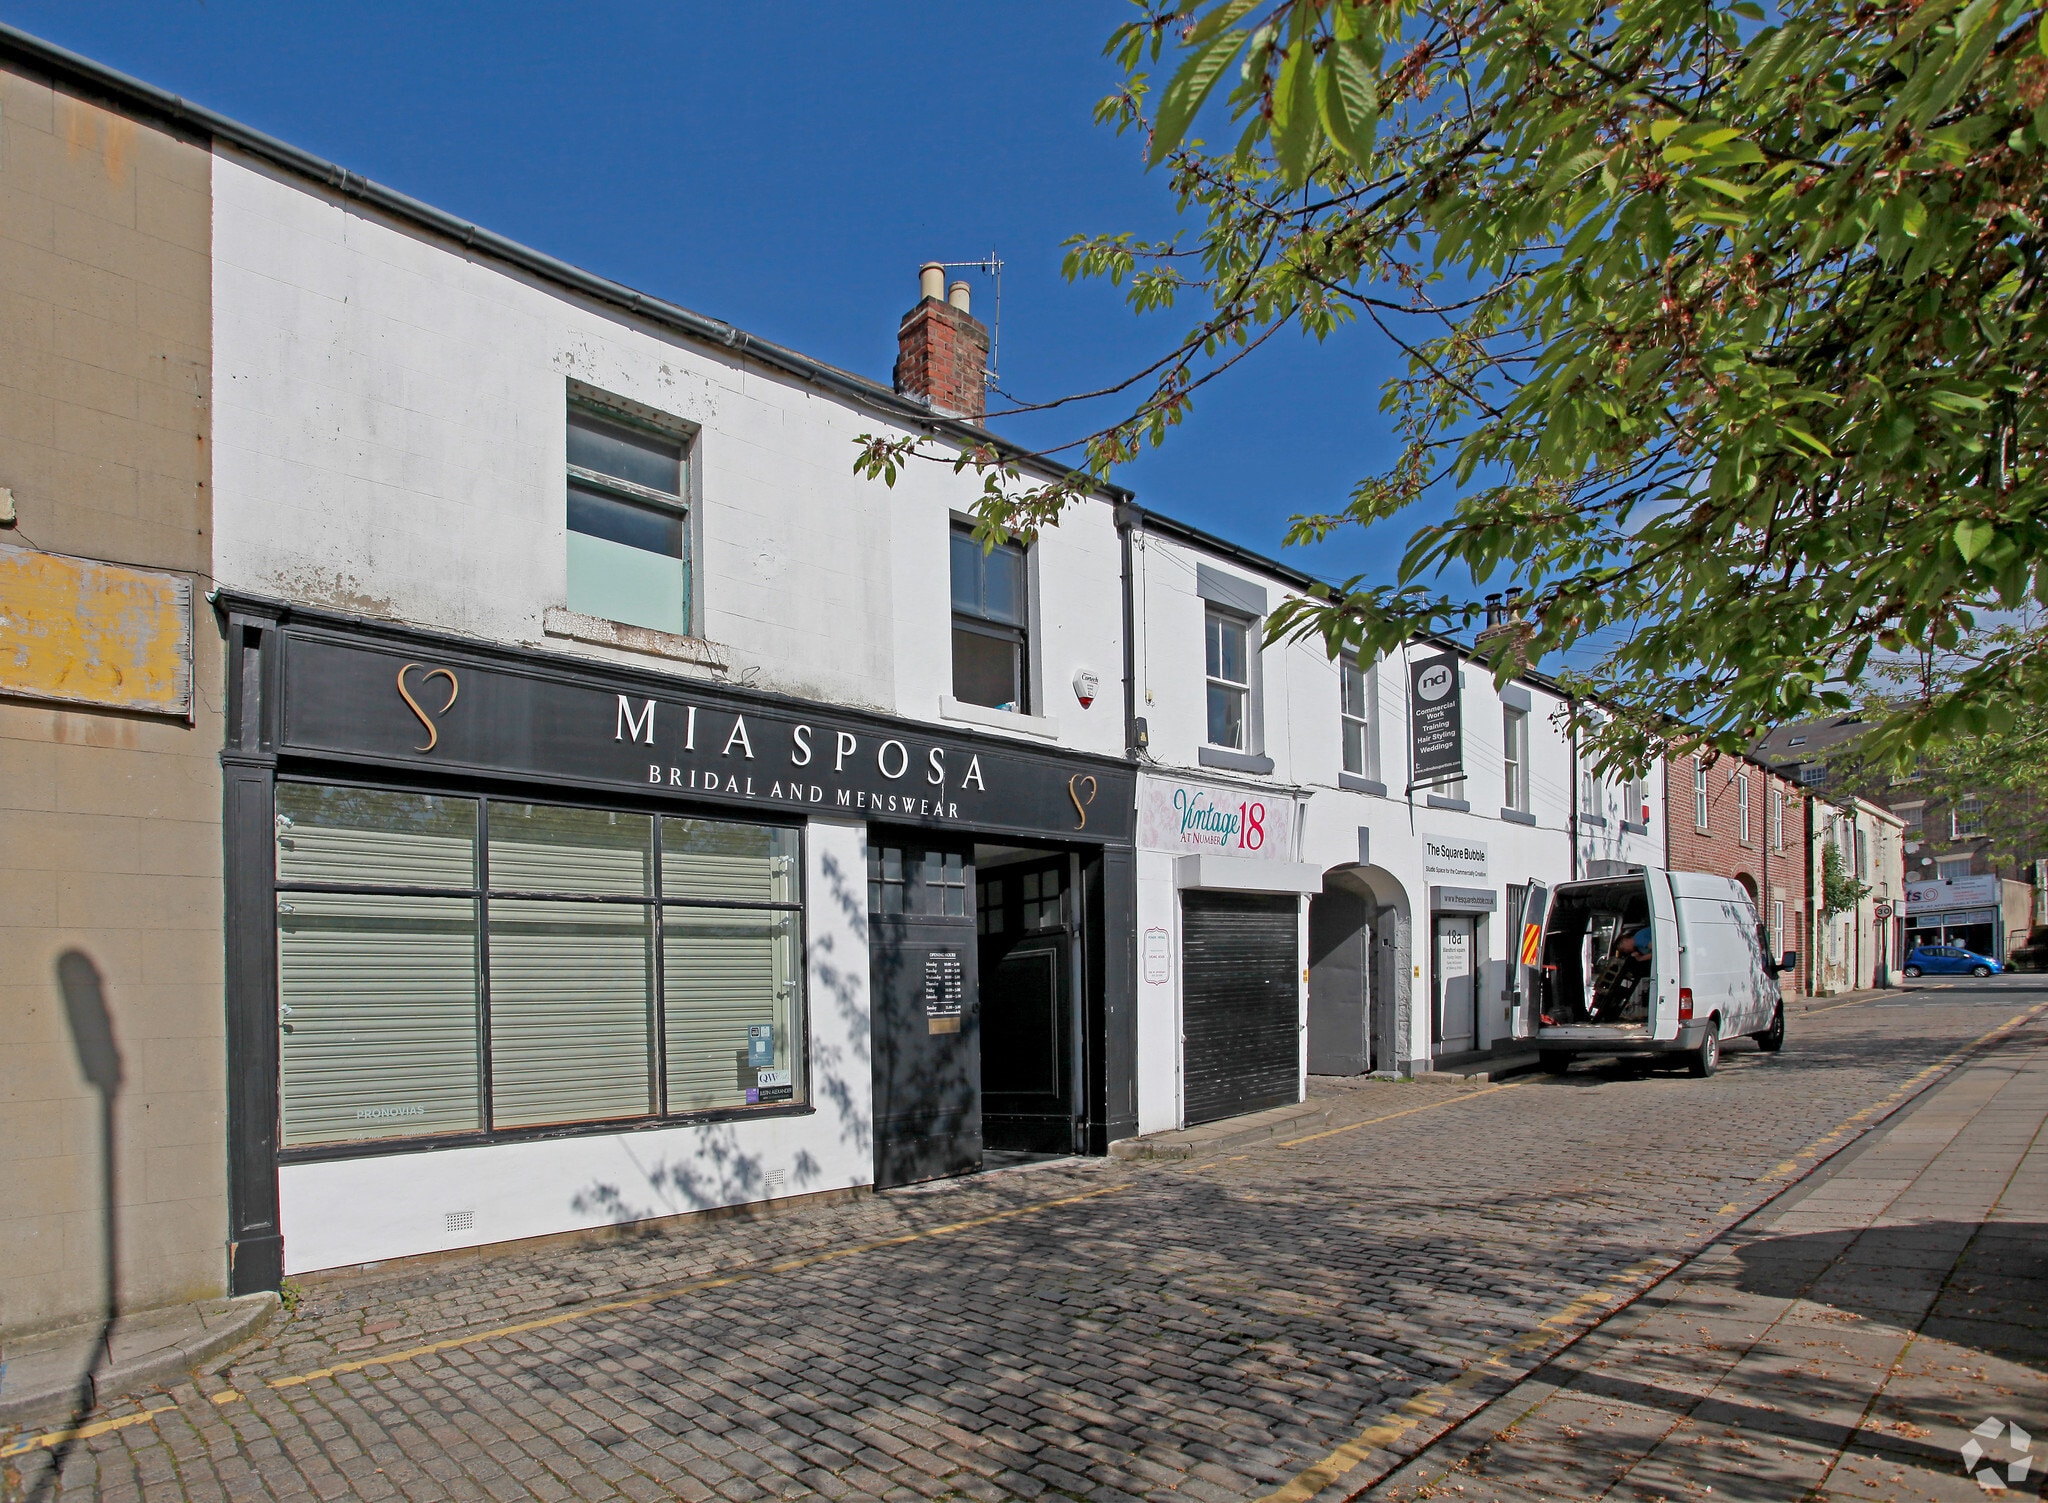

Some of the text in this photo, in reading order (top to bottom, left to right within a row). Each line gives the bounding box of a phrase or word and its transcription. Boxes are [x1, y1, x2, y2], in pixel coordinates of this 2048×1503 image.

[1416, 701, 1456, 716] Commercial
[1427, 711, 1445, 720] Work
[1422, 721, 1450, 732] Training
[614, 694, 986, 792] MIA SPOSA
[1417, 730, 1456, 744] Hair Styling
[1420, 740, 1453, 754] Weddings
[648, 764, 960, 819] BRIDAL AND MENSWEAR
[1173, 788, 1266, 850] Vintage 18
[1426, 842, 1485, 862] The Square Bubble
[1447, 929, 1462, 945] 18a
[357, 1105, 425, 1119] PRONOVIAS
